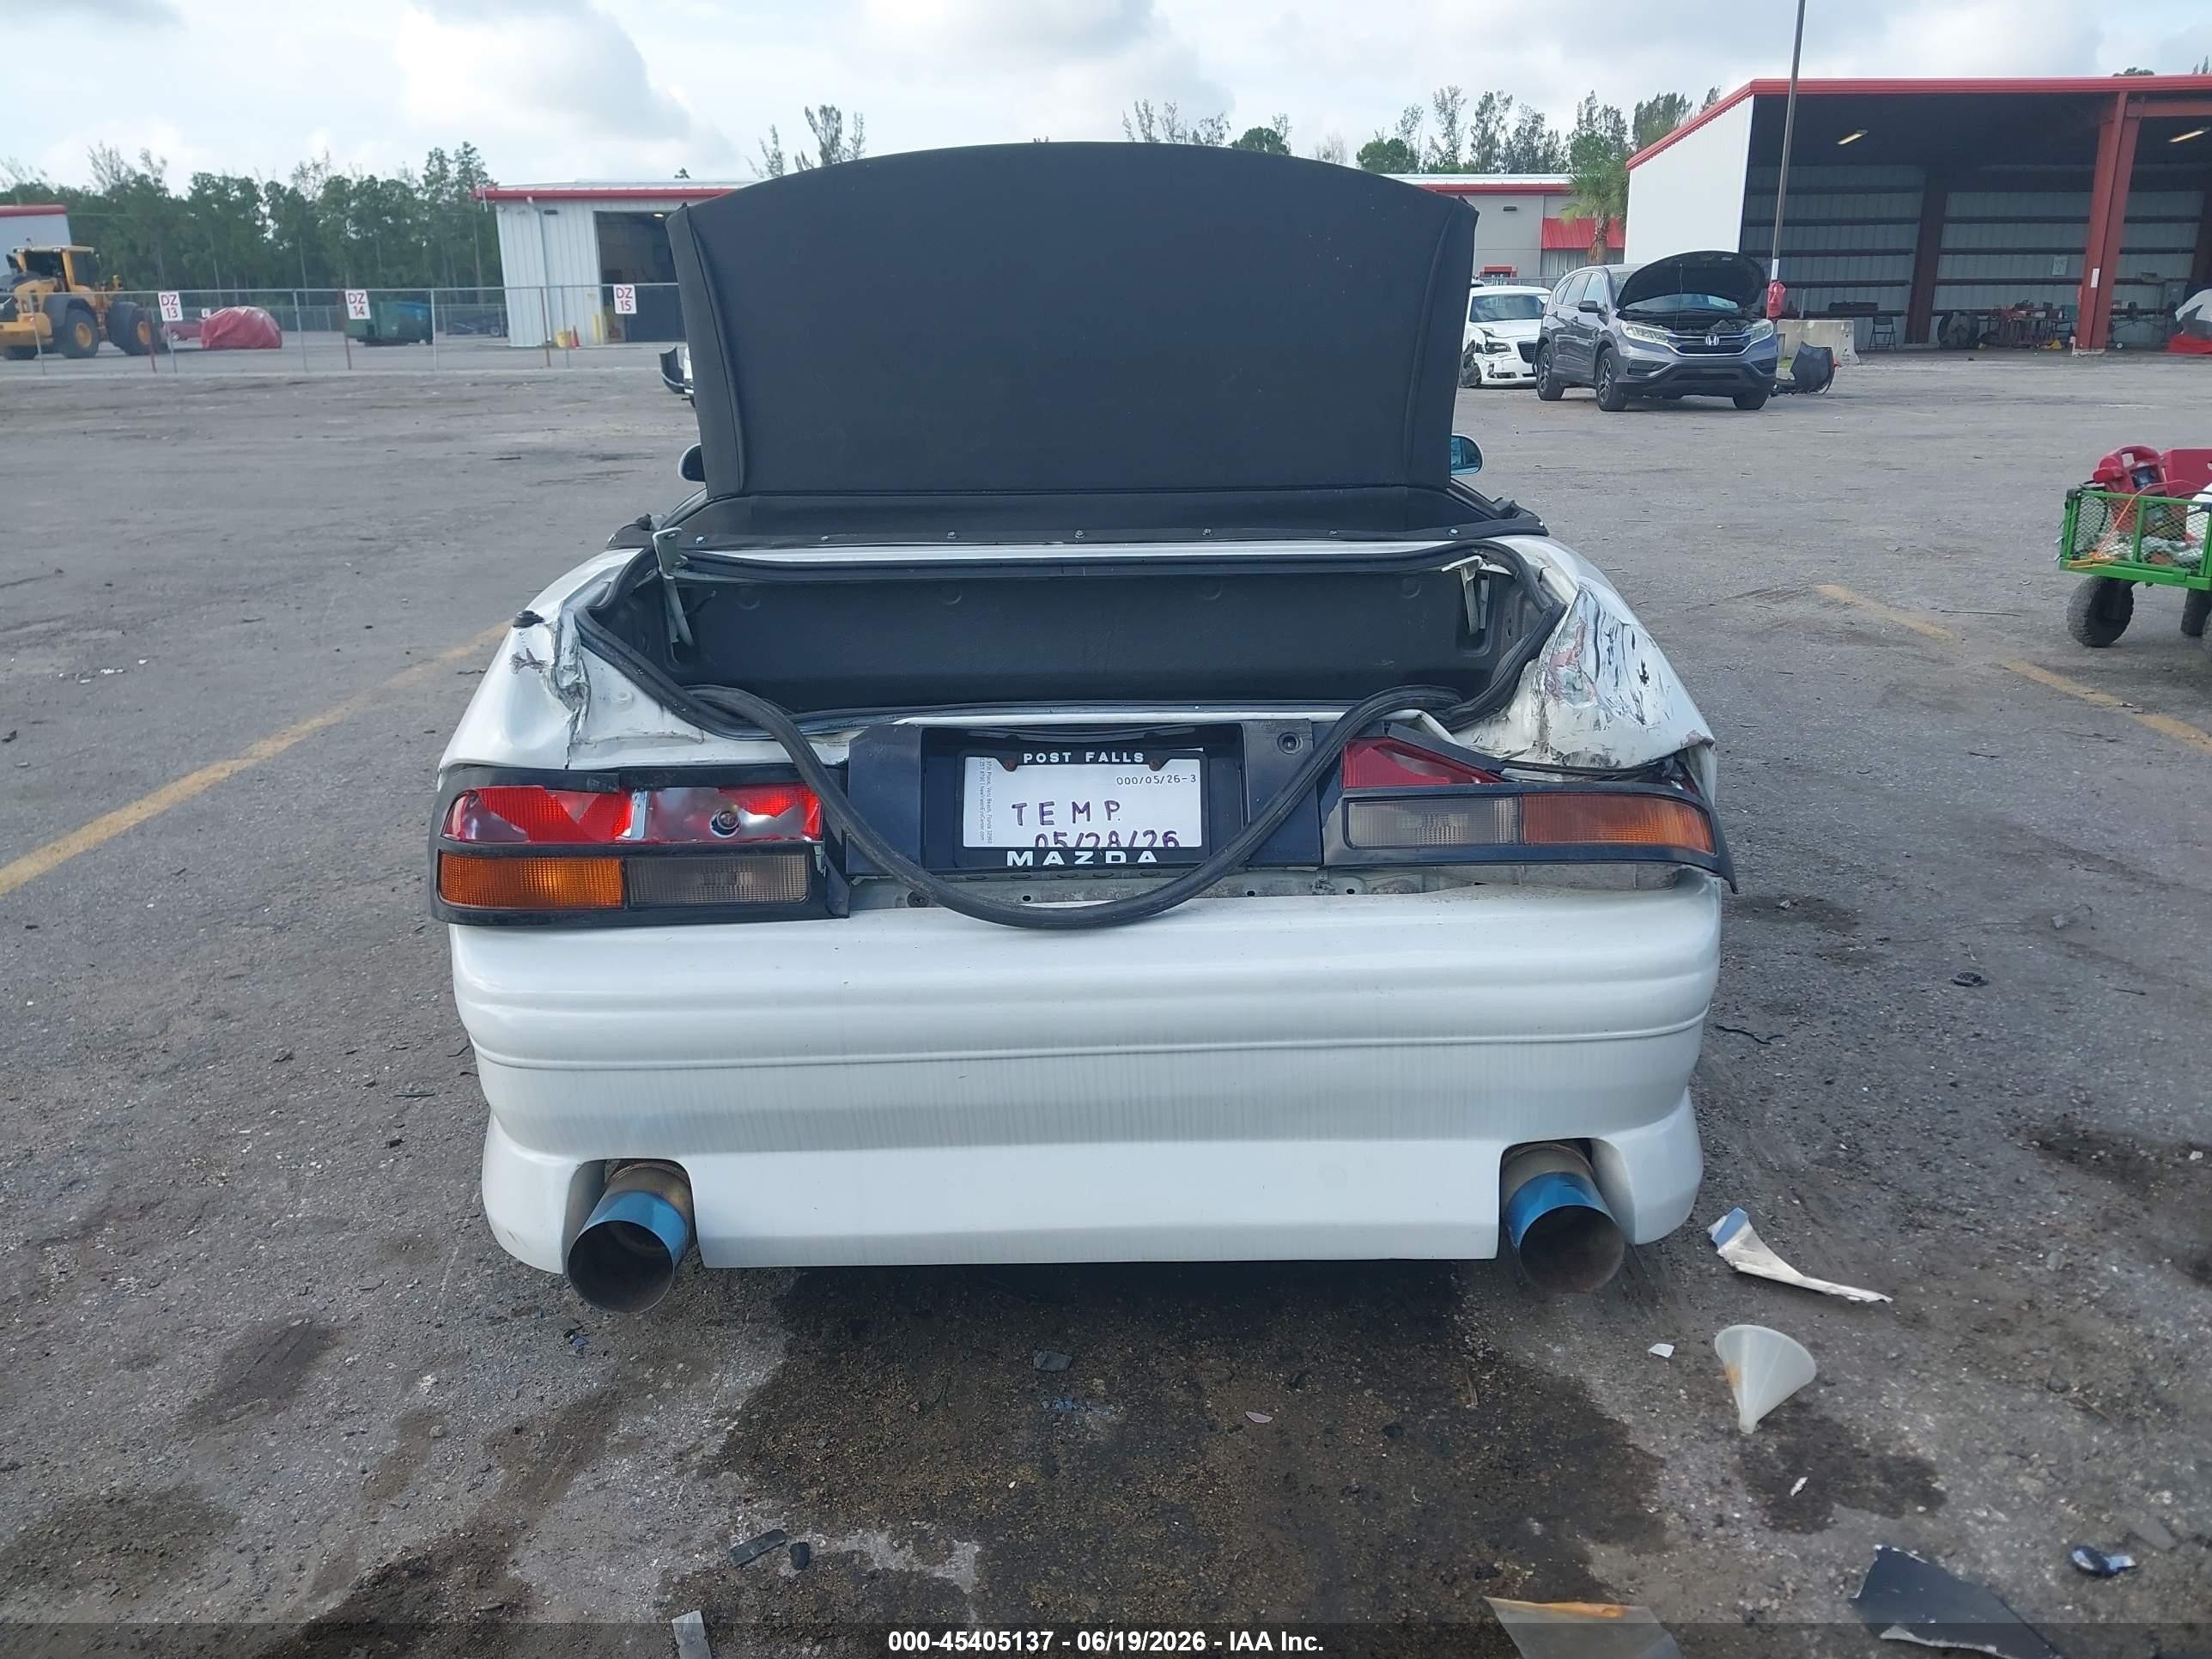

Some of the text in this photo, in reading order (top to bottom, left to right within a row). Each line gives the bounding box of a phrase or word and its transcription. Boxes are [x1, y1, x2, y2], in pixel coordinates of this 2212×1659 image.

[347, 293, 365, 304] DZ
[616, 288, 633, 299] DZ
[161, 295, 178, 306] DZ
[620, 300, 632, 311] 15
[166, 307, 179, 318] 13
[353, 306, 365, 316] 14
[1023, 751, 1145, 763] POST FALLS
[1035, 830, 1180, 848] 05/28/26
[1006, 850, 1158, 866] MAZDA
